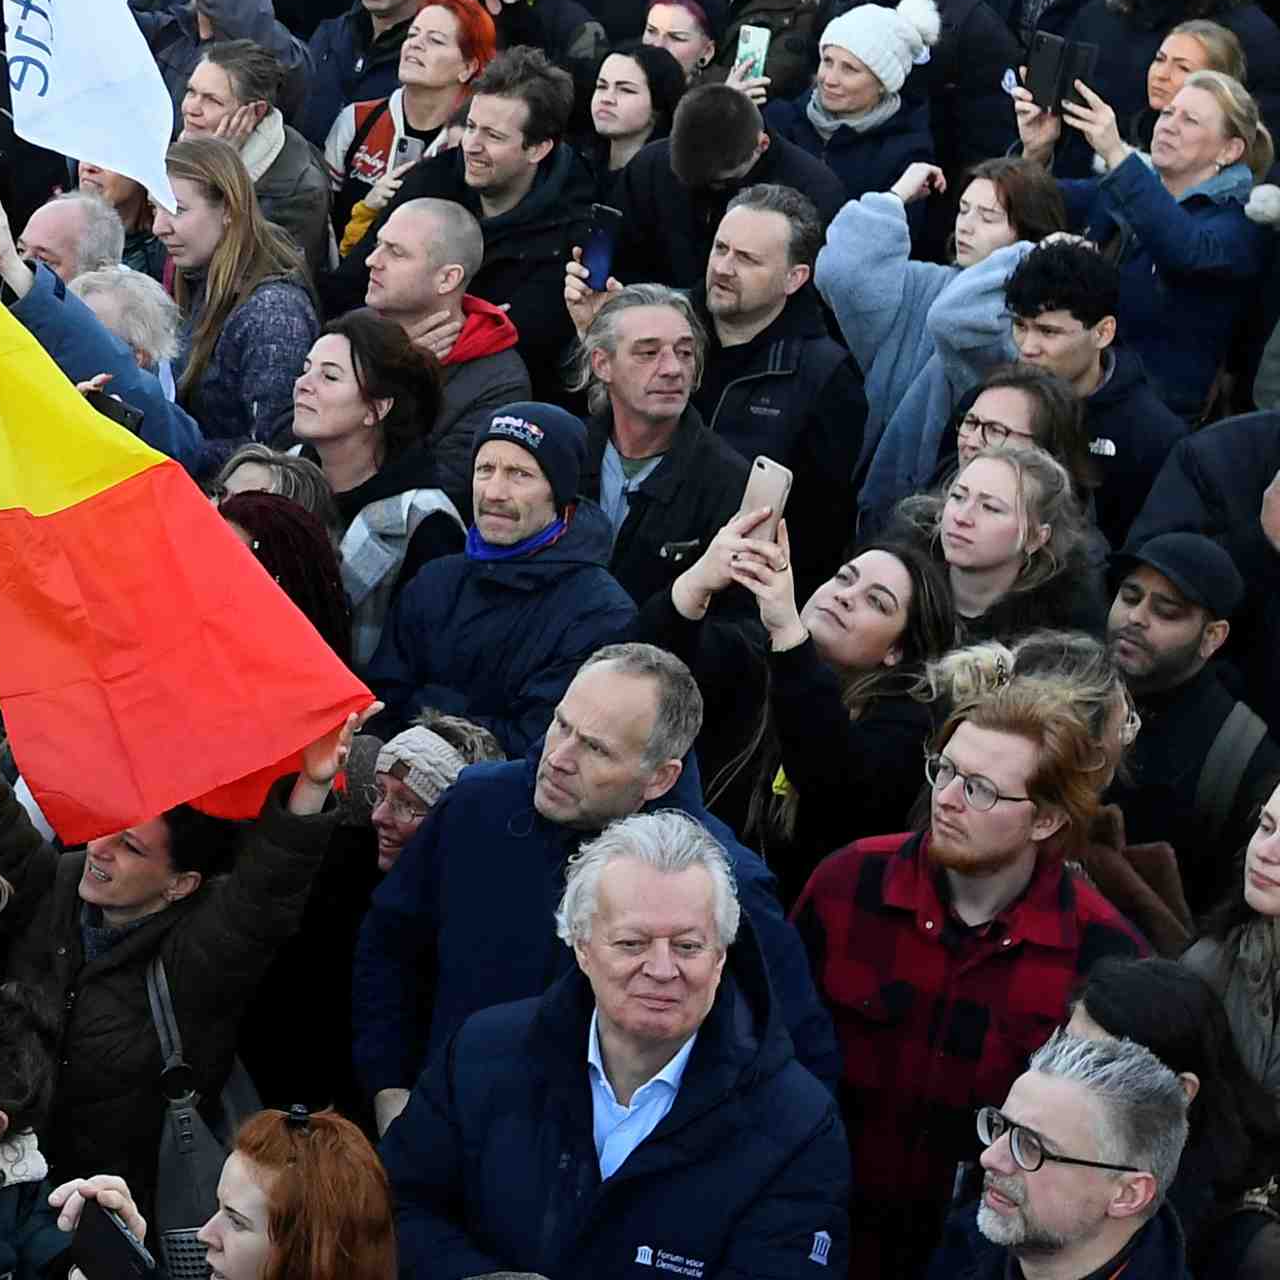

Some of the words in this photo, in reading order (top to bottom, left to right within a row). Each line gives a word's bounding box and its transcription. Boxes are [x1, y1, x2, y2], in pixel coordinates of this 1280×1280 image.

[657, 1248, 684, 1265] Forum
[686, 1256, 705, 1268] voor
[655, 1258, 704, 1279] Democratie
